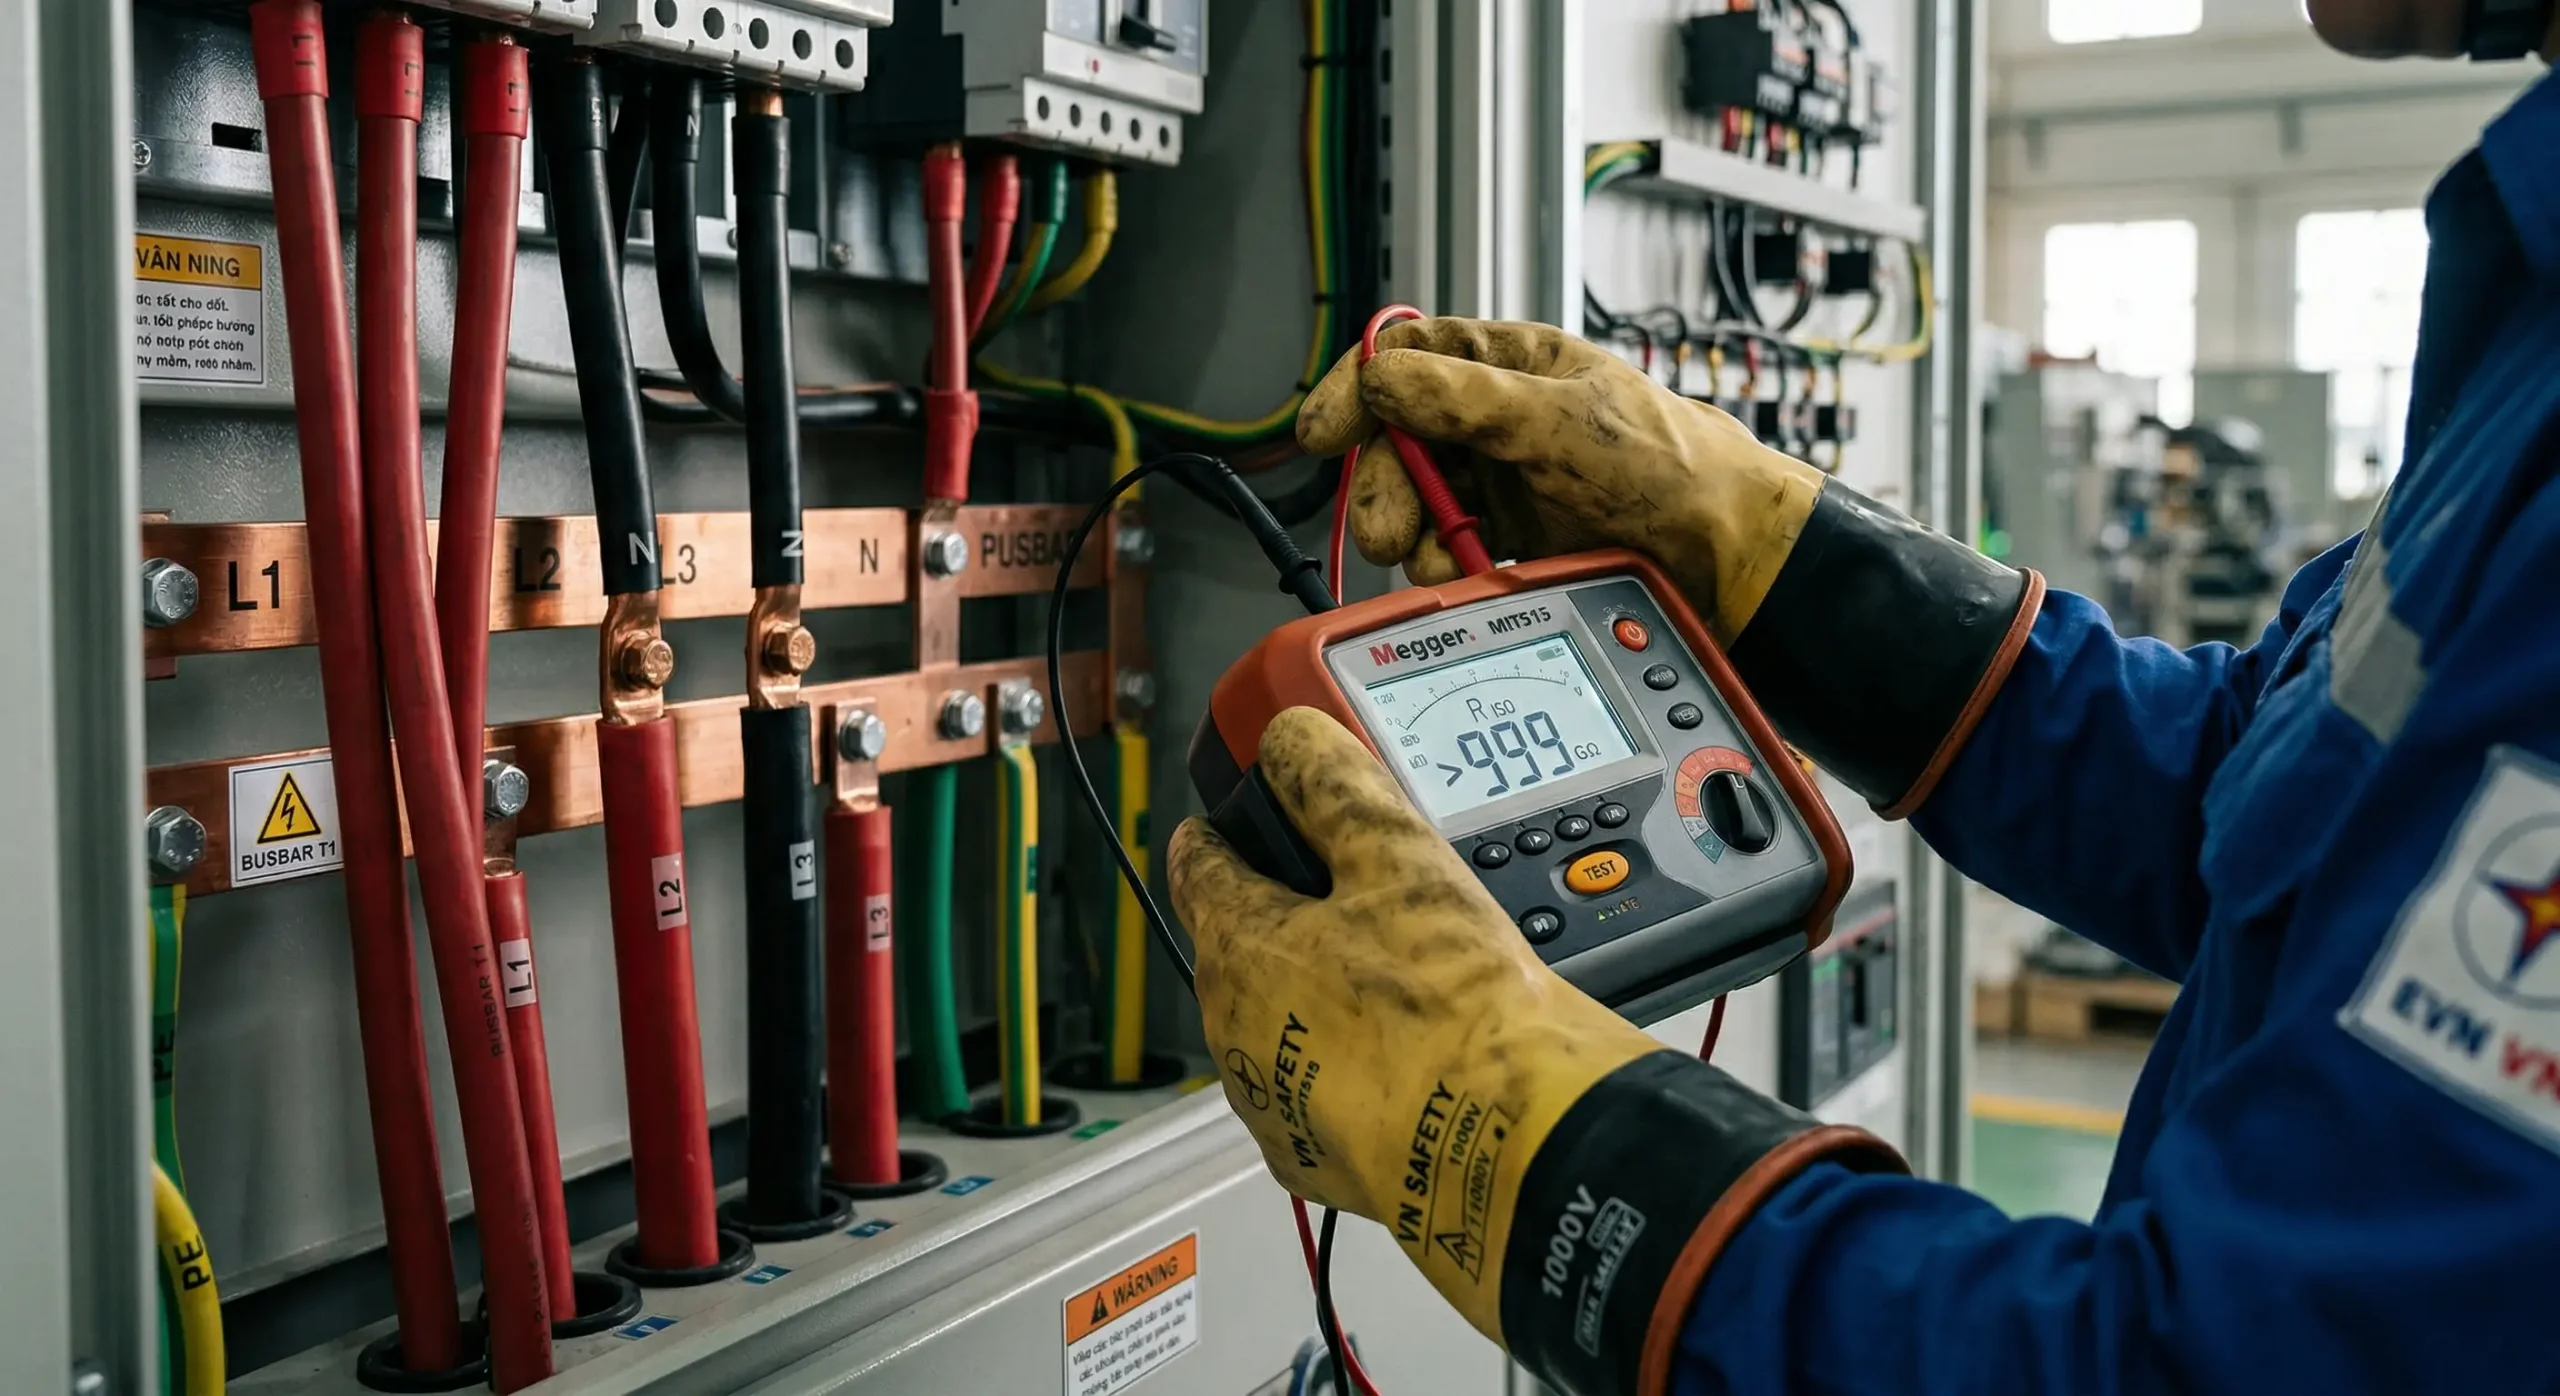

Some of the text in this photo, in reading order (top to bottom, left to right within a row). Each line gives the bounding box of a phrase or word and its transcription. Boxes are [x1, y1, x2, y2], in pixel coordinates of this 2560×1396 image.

[188, 253, 240, 278] NING
[180, 297, 202, 310] cho
[628, 531, 657, 565] N
[860, 538, 879, 574] N
[228, 560, 280, 612] L1
[514, 546, 562, 592] L2
[1487, 606, 1552, 635] MIT515
[1466, 697, 1517, 723] R ISO
[241, 840, 337, 872] BUSBAR T1
[795, 853, 815, 887] L3
[1582, 860, 1617, 882] TEST
[658, 878, 684, 917] L2
[870, 905, 890, 940] L3
[506, 959, 533, 995] L1
[2391, 976, 2495, 1060] EVN
[153, 1029, 175, 1083] PE
[1275, 1011, 1309, 1129] SAFETY
[1288, 1130, 1319, 1169] VN
[1449, 1102, 1483, 1166] 1000V
[1397, 1080, 1455, 1243] VN SAFETY
[1541, 1183, 1598, 1299] 1000V
[174, 1233, 211, 1292] PE
